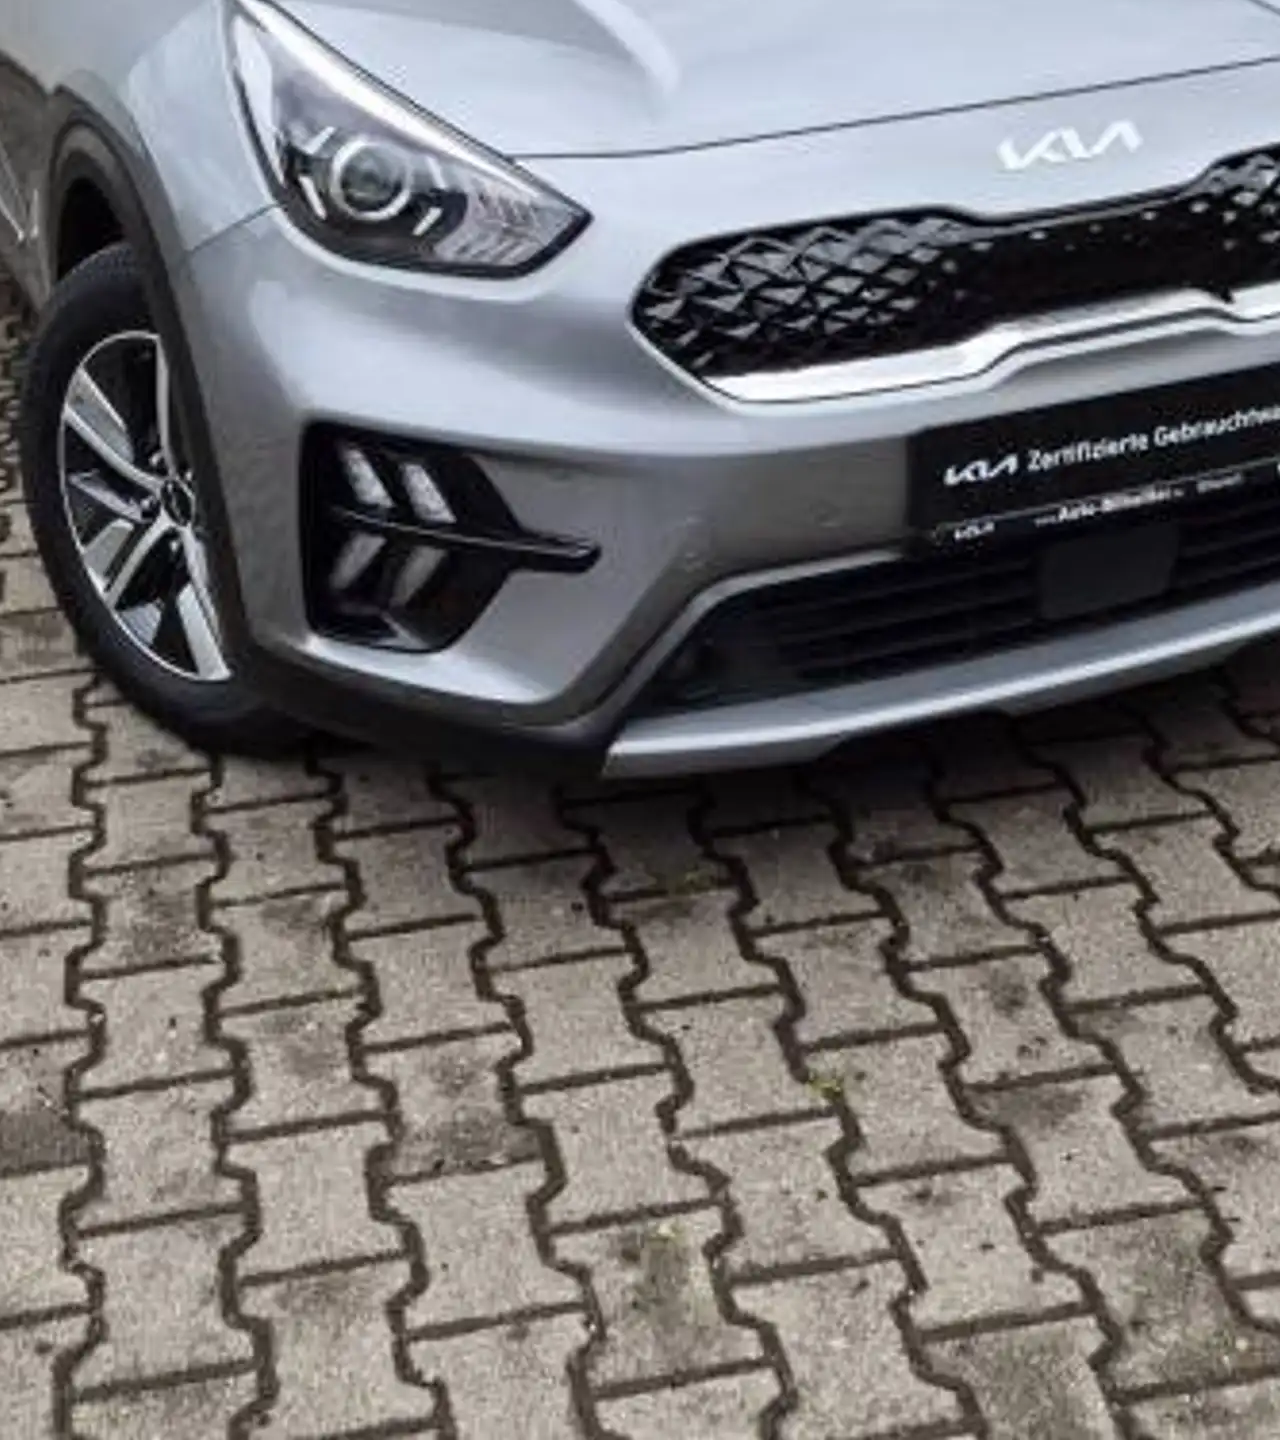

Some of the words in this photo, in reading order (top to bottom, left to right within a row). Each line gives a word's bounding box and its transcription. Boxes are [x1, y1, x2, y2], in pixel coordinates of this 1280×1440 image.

[996, 120, 1143, 170] KIA
[943, 454, 1018, 486] KIA
[1027, 432, 1149, 473] Zertifizierte
